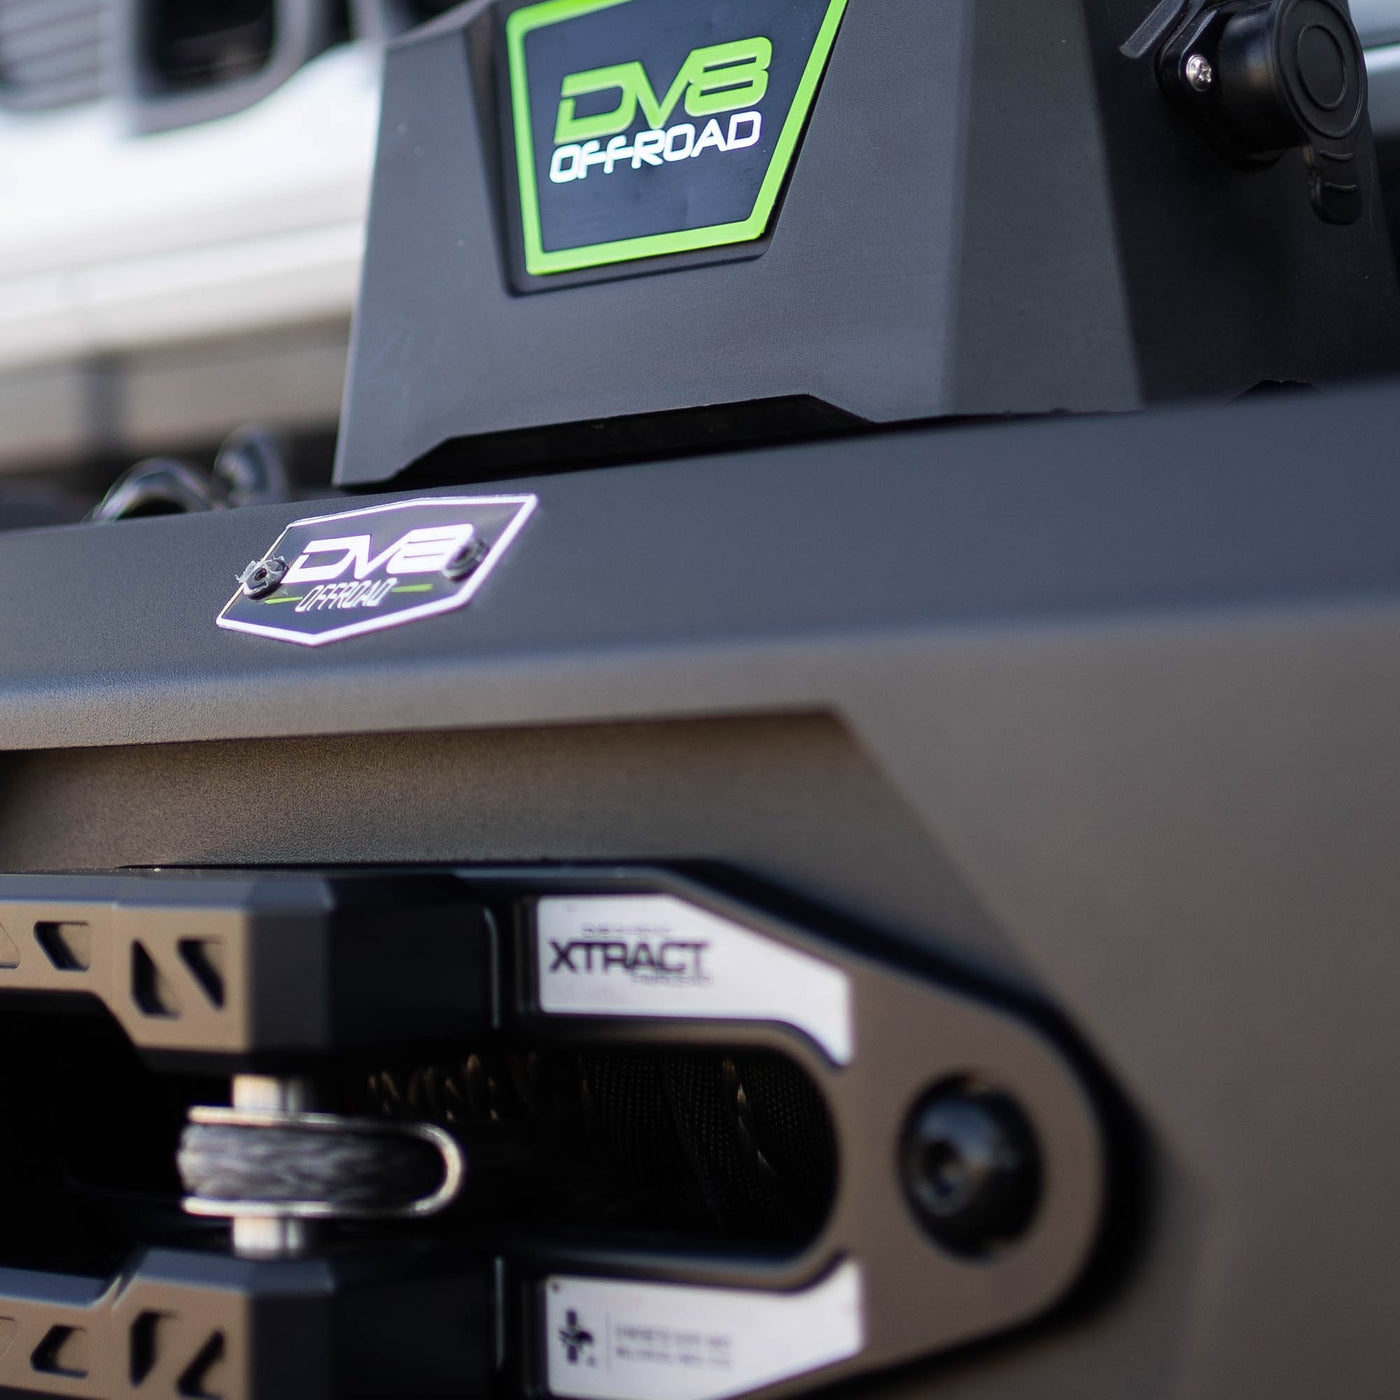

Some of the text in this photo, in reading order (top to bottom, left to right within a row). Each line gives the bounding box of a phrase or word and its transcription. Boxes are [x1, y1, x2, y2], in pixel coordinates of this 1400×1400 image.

[554, 36, 773, 145] DV8
[280, 523, 474, 584] DV8
[295, 577, 399, 613] OFFROAD
[548, 940, 710, 975] XTRACT
